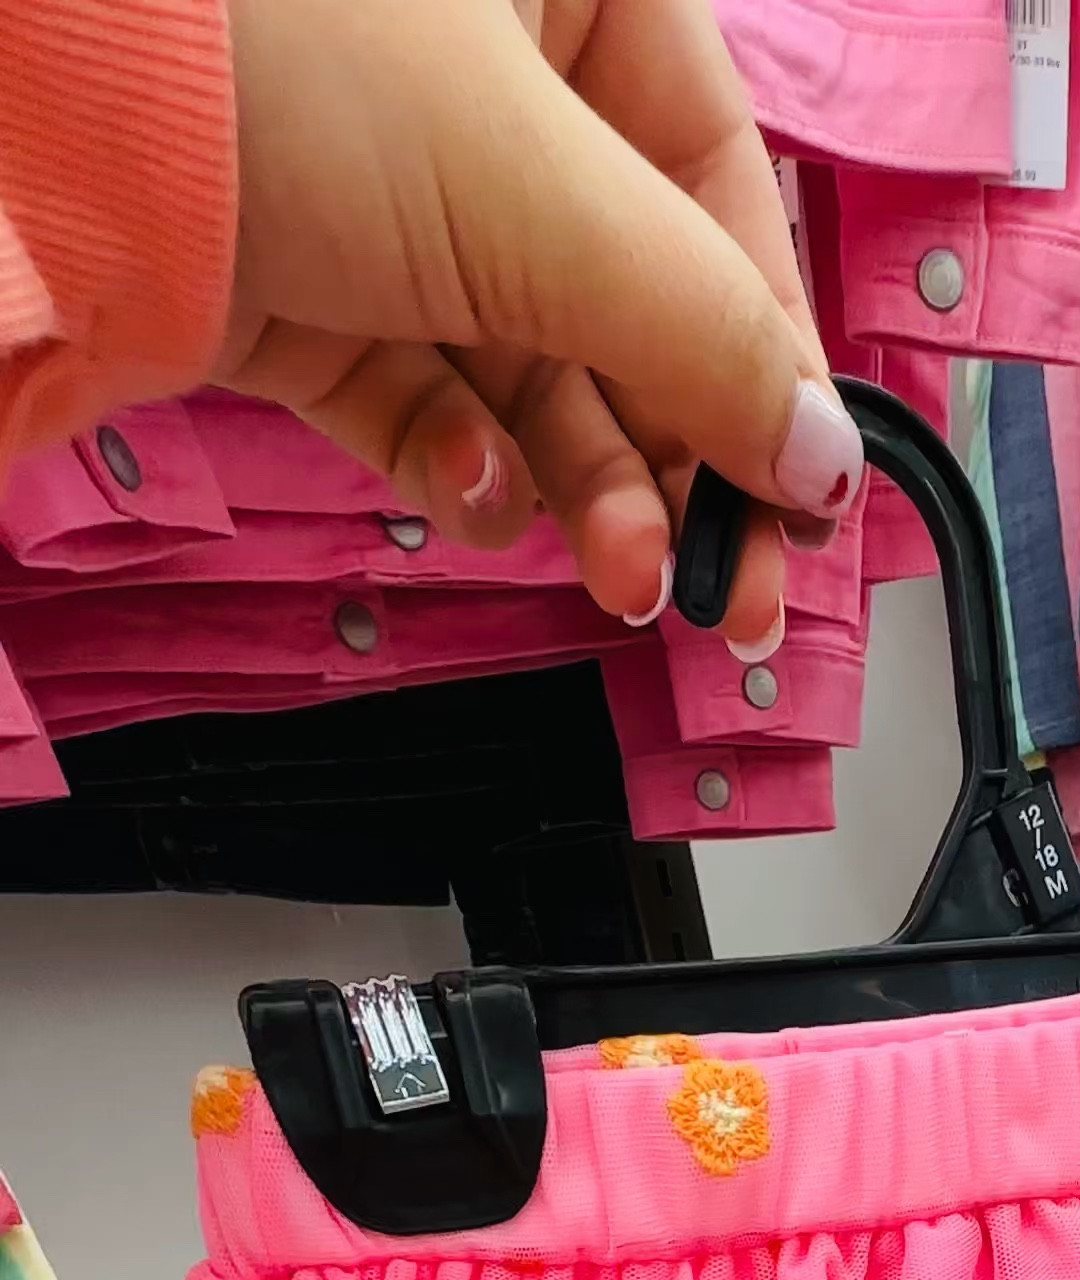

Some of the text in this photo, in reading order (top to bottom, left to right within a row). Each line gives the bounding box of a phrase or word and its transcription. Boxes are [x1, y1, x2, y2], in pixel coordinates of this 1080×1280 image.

[1019, 804, 1045, 831] 12
[1034, 844, 1059, 871] 18
[1044, 870, 1068, 899] M
